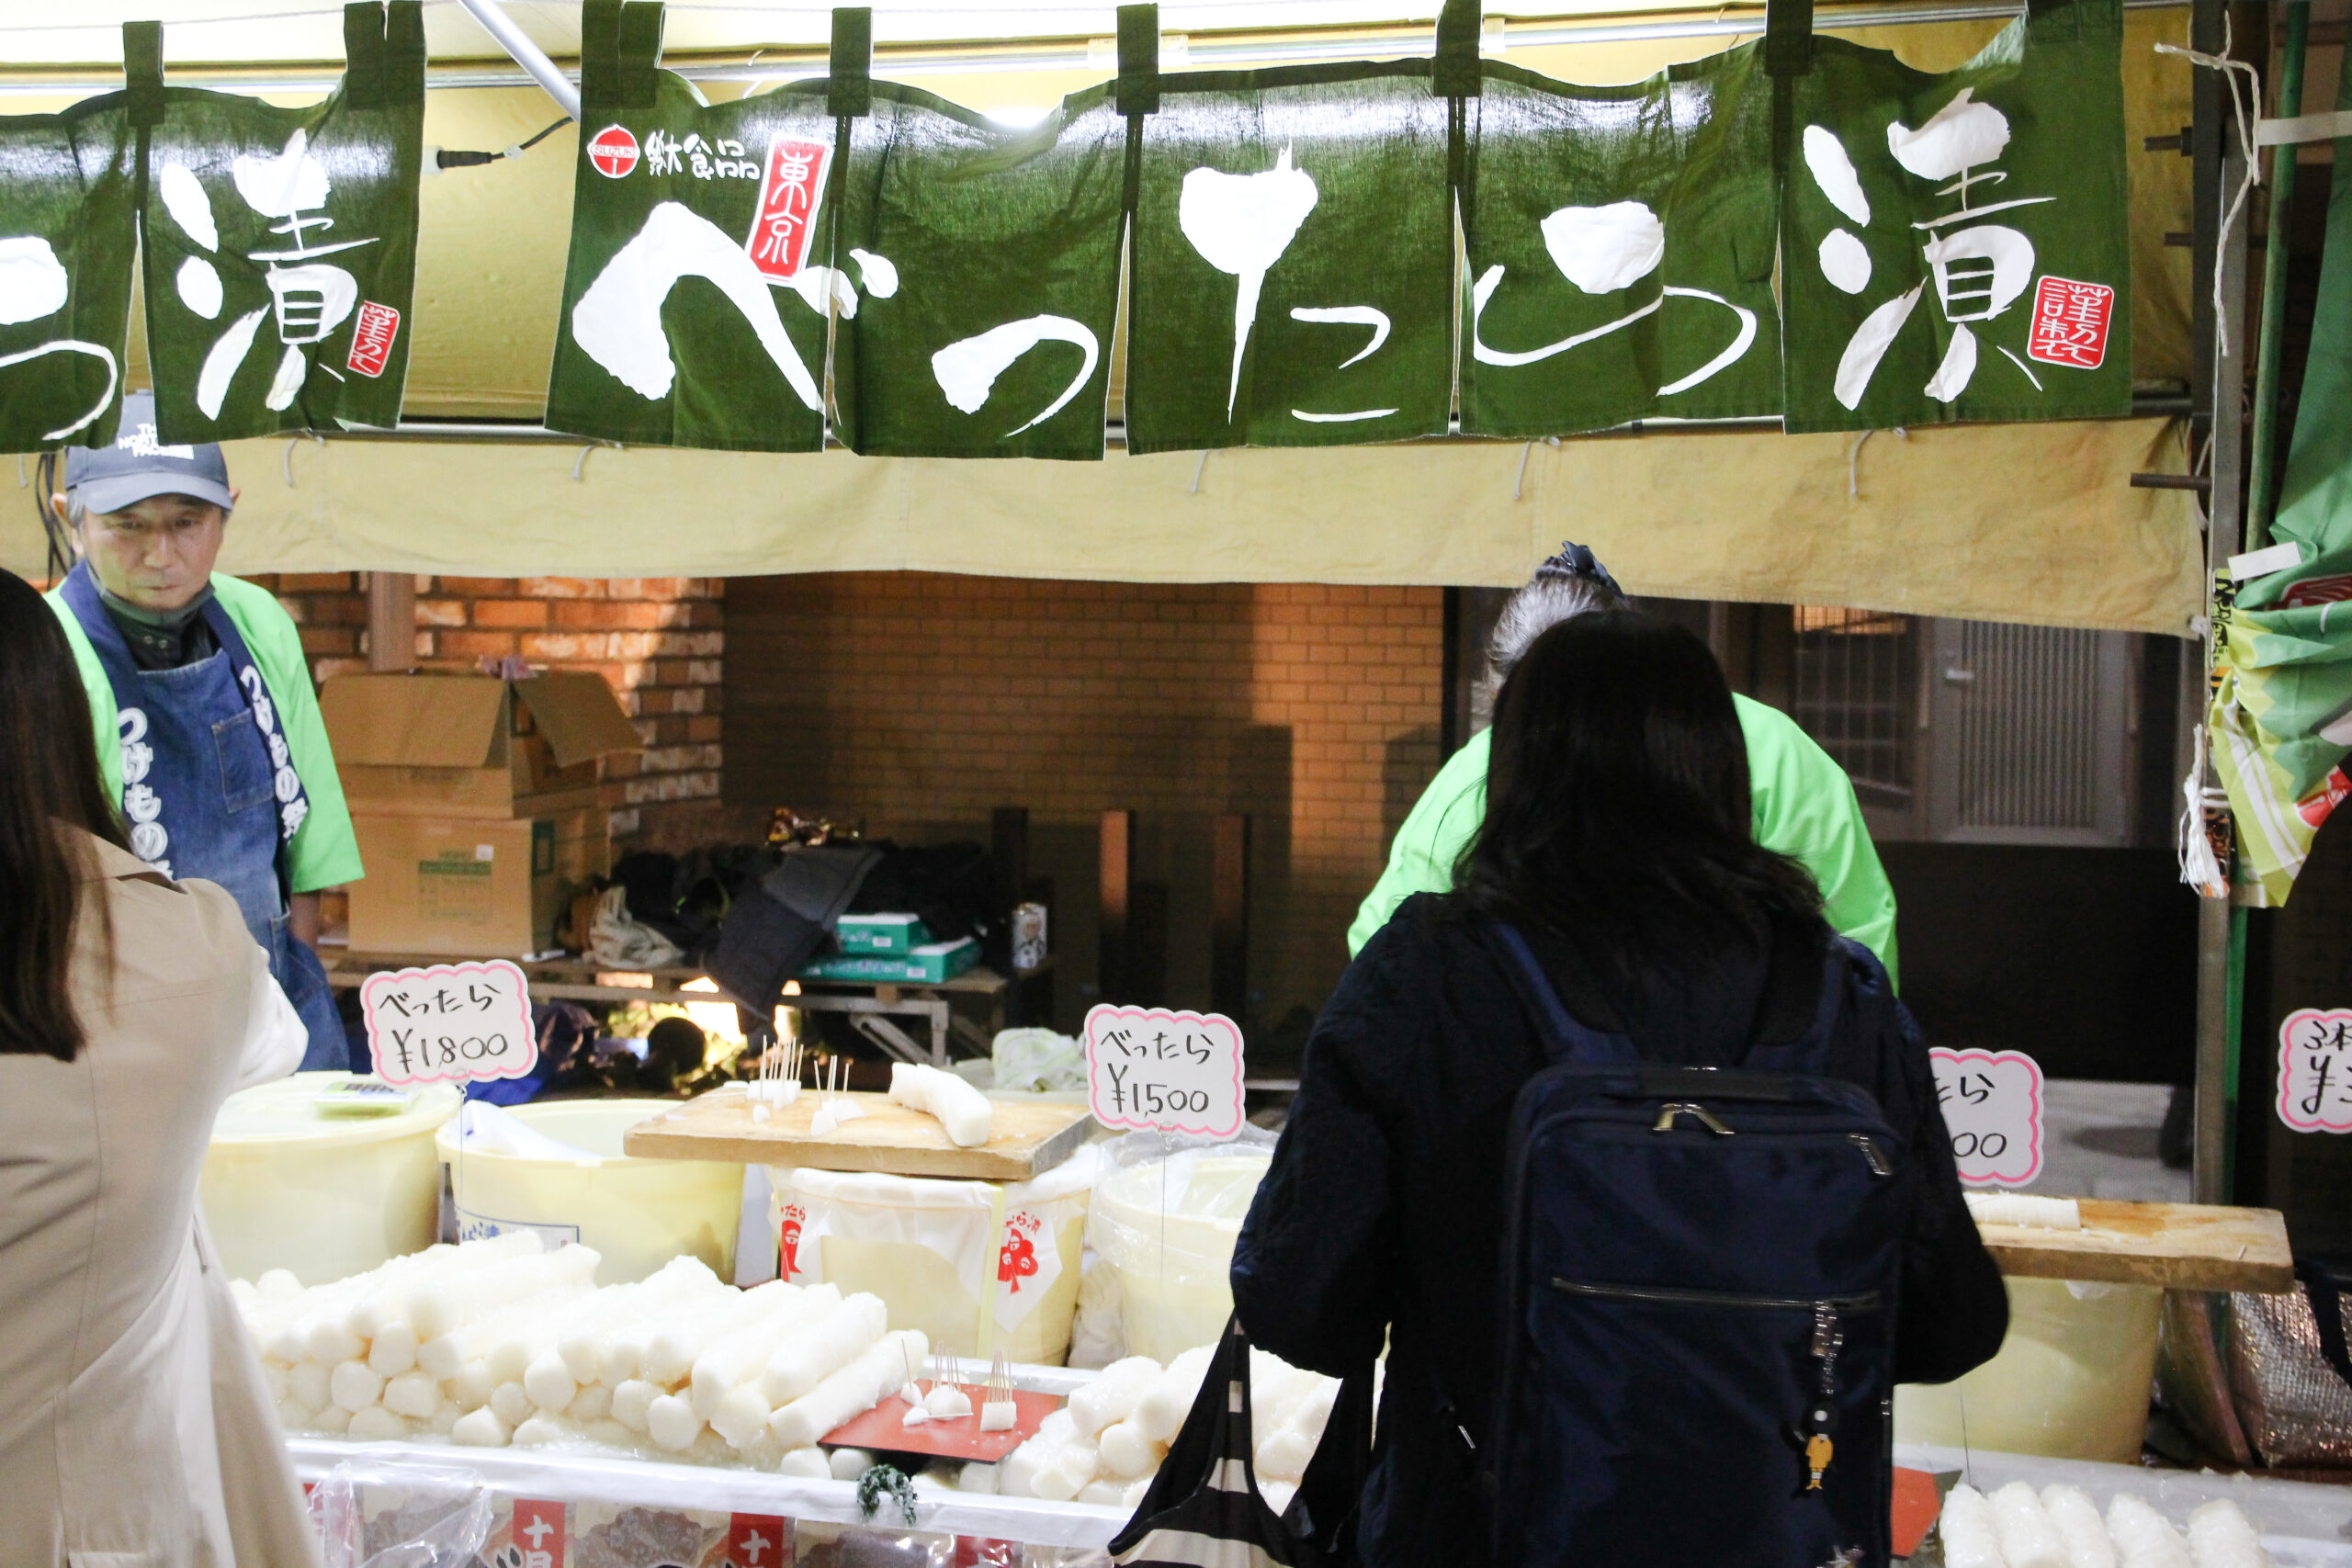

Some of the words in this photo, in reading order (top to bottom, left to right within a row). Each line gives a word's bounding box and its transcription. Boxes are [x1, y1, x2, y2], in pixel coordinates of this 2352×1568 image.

[758, 148, 815, 265] 東京
[379, 984, 502, 1018] べったら
[1100, 1030, 1215, 1065] べったら
[1107, 1063, 1209, 1118] ¥1,500
